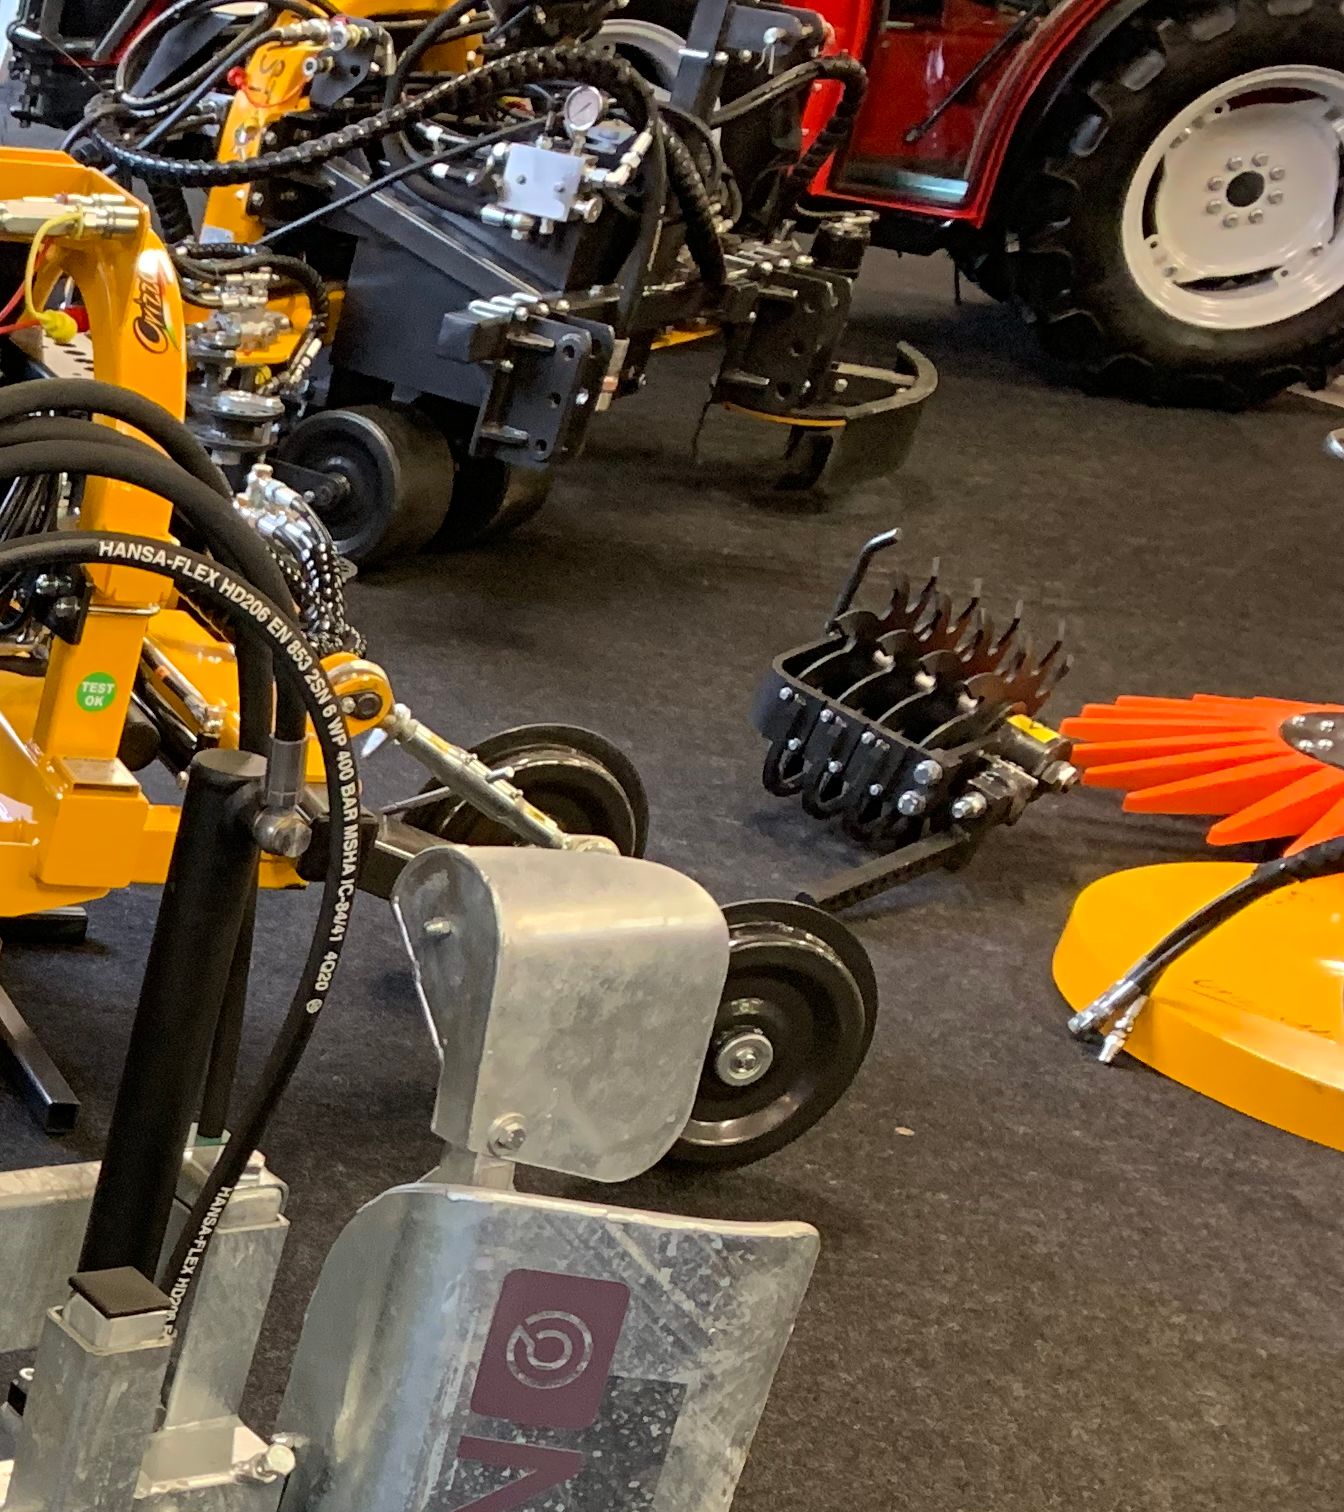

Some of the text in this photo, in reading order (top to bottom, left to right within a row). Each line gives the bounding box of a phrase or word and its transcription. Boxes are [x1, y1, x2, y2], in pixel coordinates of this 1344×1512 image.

[82, 680, 115, 695] TEST
[84, 694, 105, 707] OK
[98, 539, 359, 992] HANSA-FLEX HD206 EN 853 2SN 6 WP 400 BAR MSHA IC-84/41 4Q20
[180, 1185, 234, 1275] HANSA-FLEX
